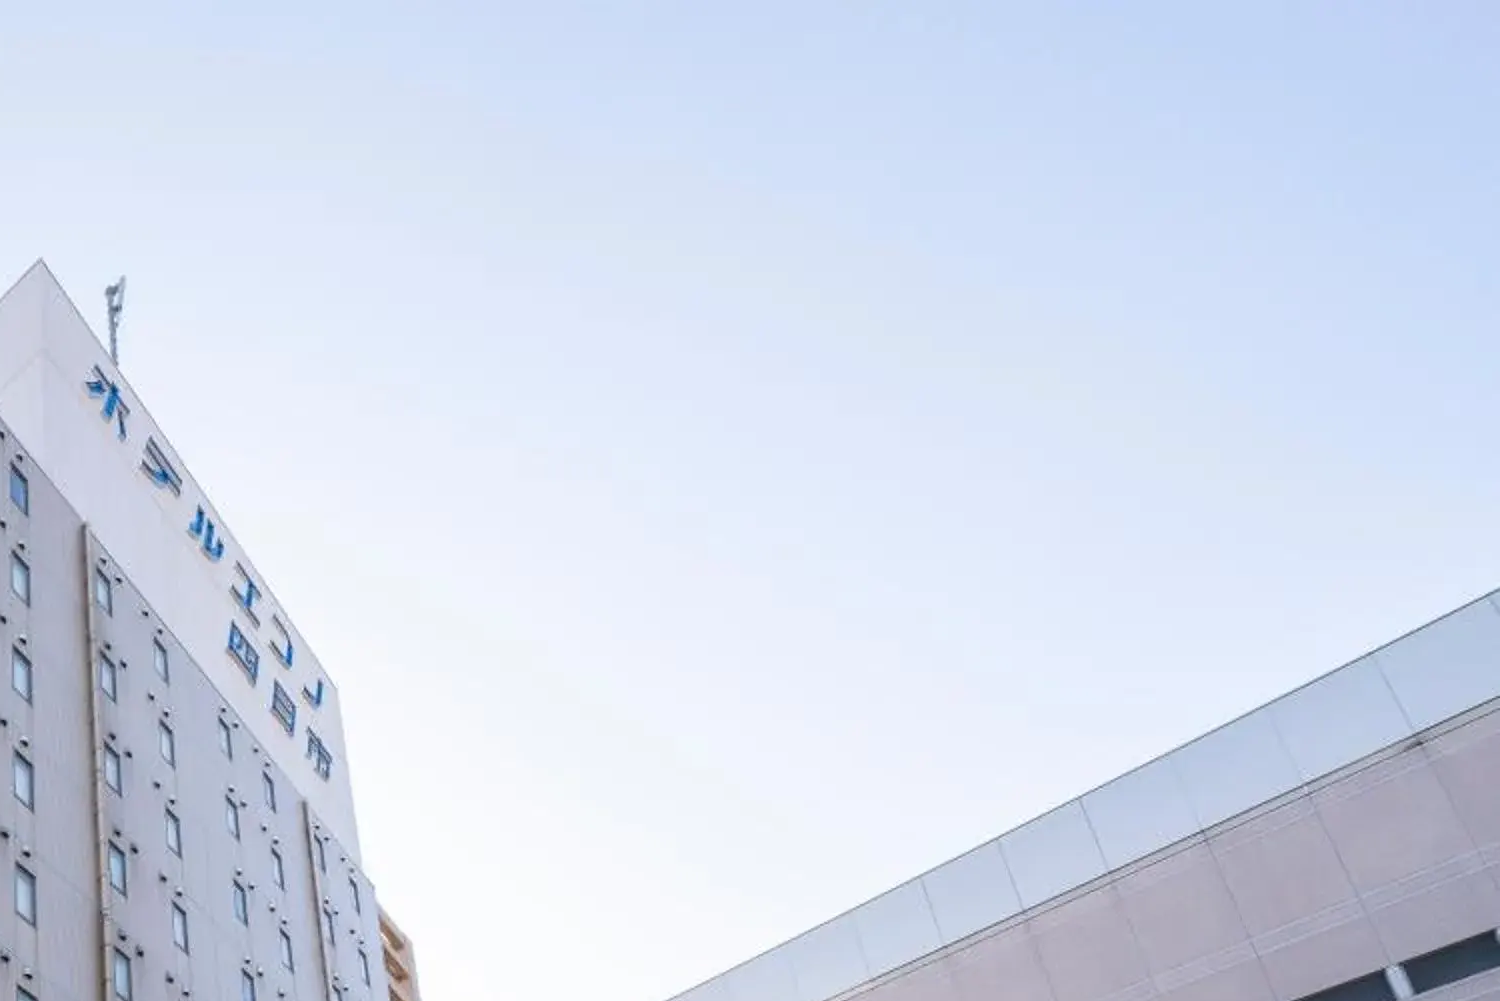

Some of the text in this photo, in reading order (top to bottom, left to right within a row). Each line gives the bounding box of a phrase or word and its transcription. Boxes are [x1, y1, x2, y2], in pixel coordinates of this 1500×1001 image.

[84, 364, 323, 711] ホテルエコノ
[226, 618, 333, 783] 四日市
